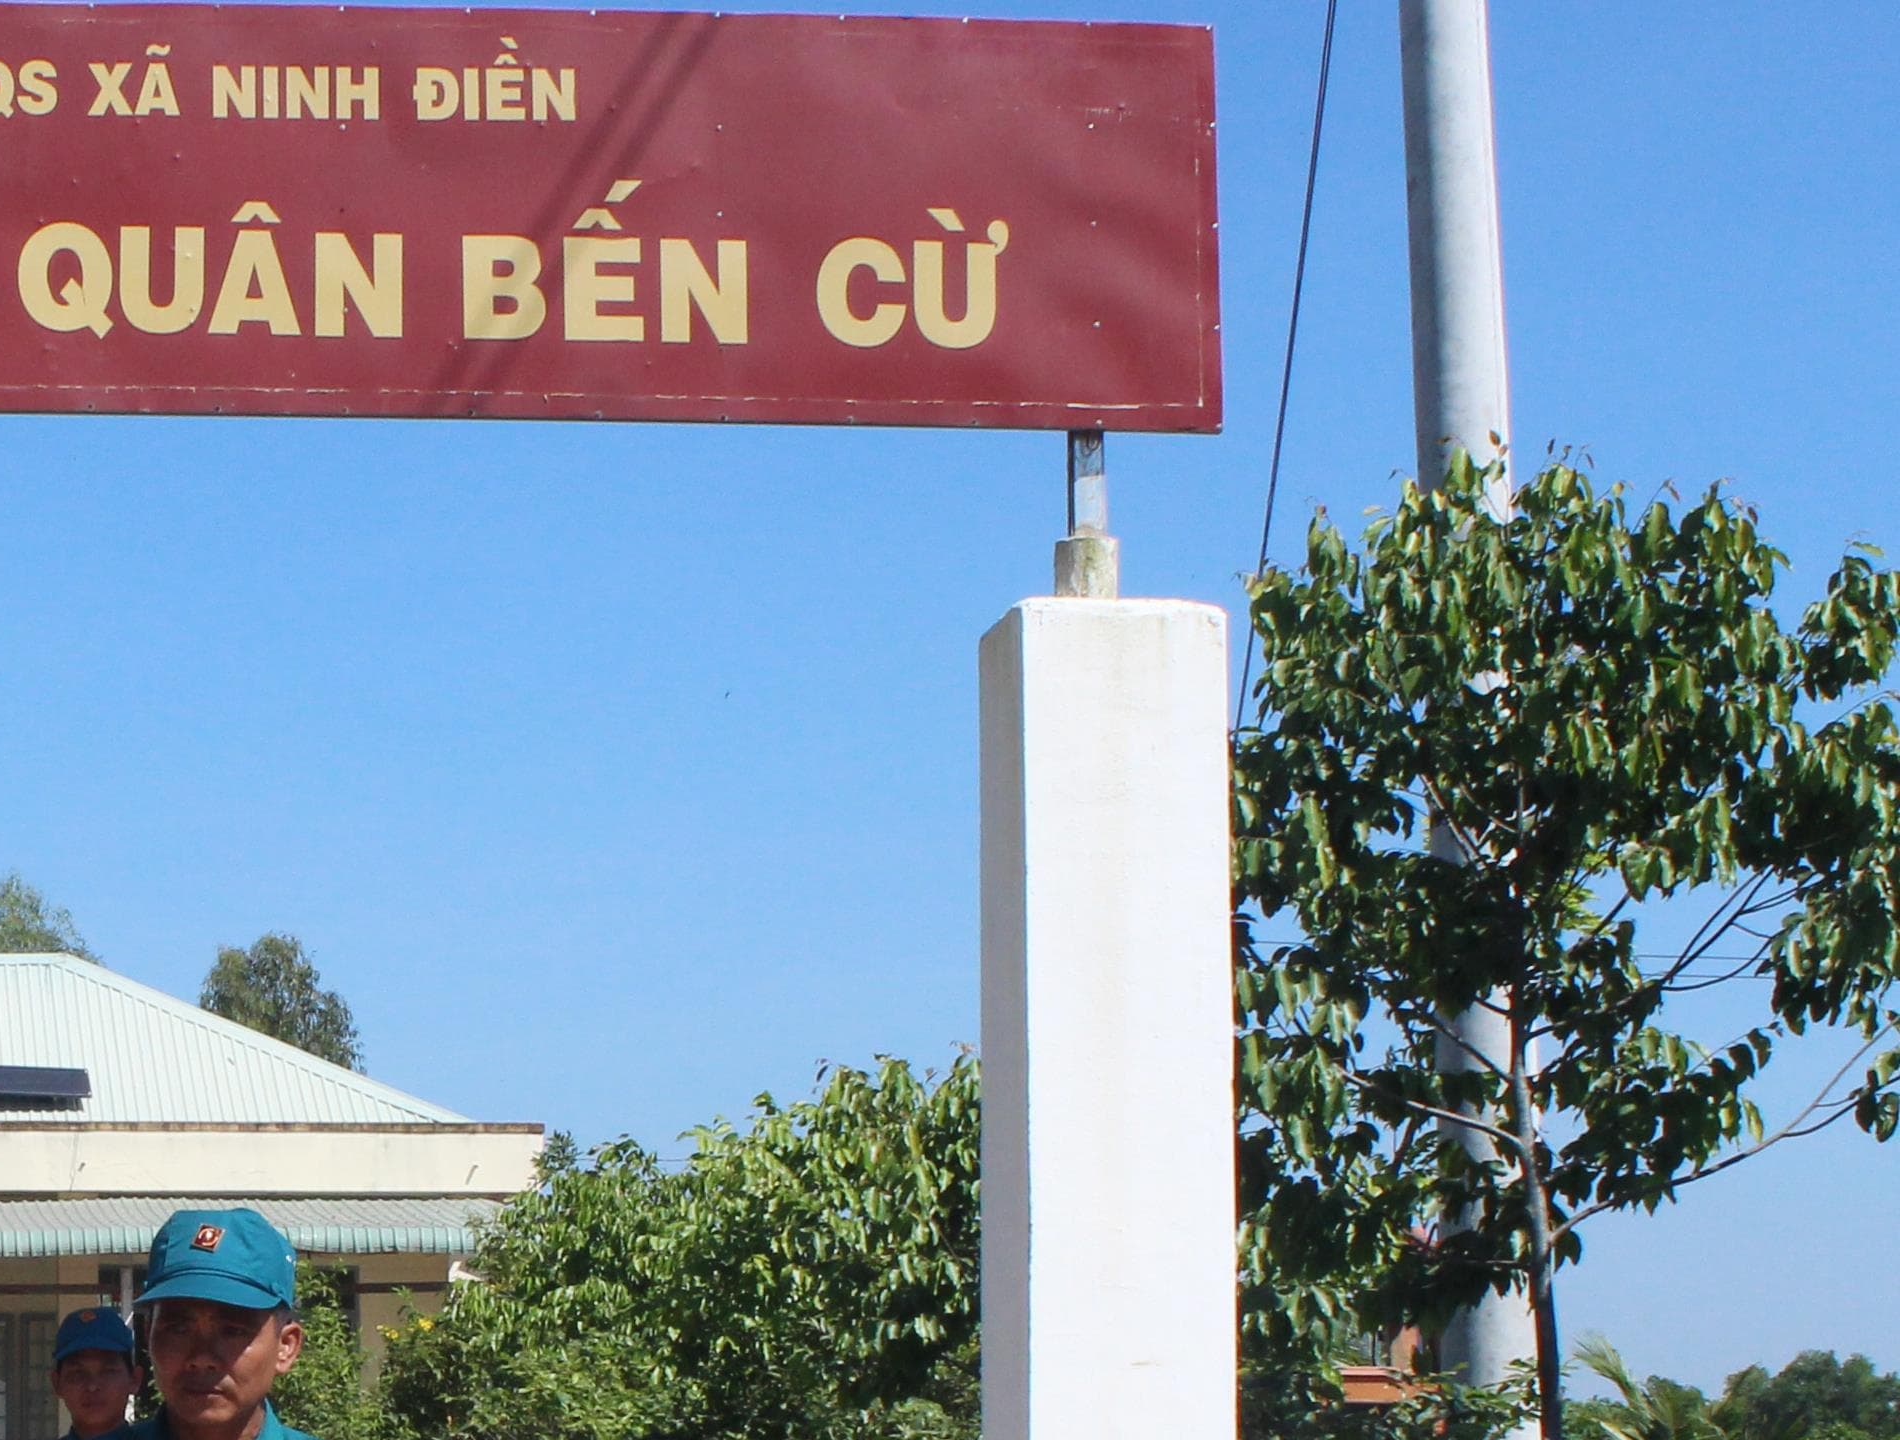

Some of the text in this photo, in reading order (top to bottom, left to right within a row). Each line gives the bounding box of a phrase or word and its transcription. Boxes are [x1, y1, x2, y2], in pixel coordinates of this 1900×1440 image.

[87, 44, 181, 116] XÃ
[212, 65, 380, 120] NINH
[411, 37, 576, 121] ĐIỀN
[17, 201, 403, 340] QUÂN
[462, 180, 748, 345] BẾN
[816, 208, 1009, 349] CỪ
